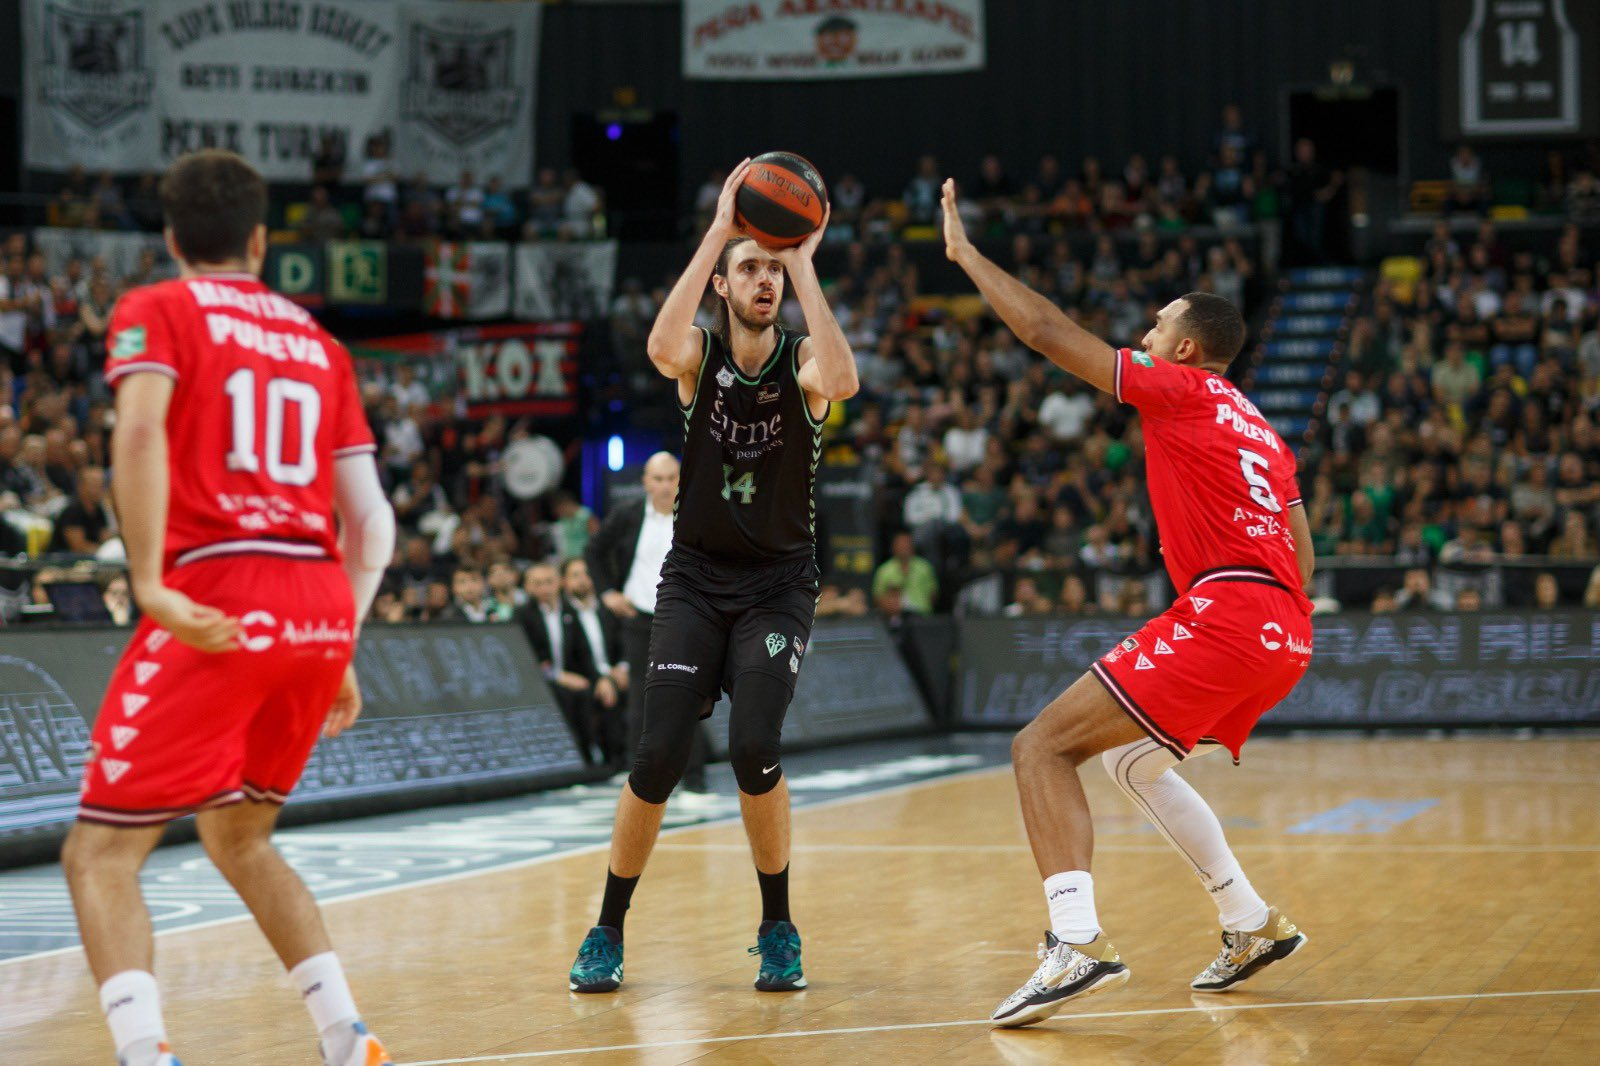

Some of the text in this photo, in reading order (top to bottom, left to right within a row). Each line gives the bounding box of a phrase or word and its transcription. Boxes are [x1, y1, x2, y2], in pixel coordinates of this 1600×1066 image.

[206, 312, 330, 371] PULEVA
[225, 368, 320, 487] 10
[1216, 403, 1280, 454] PULEVA
[1237, 447, 1282, 513] 5
